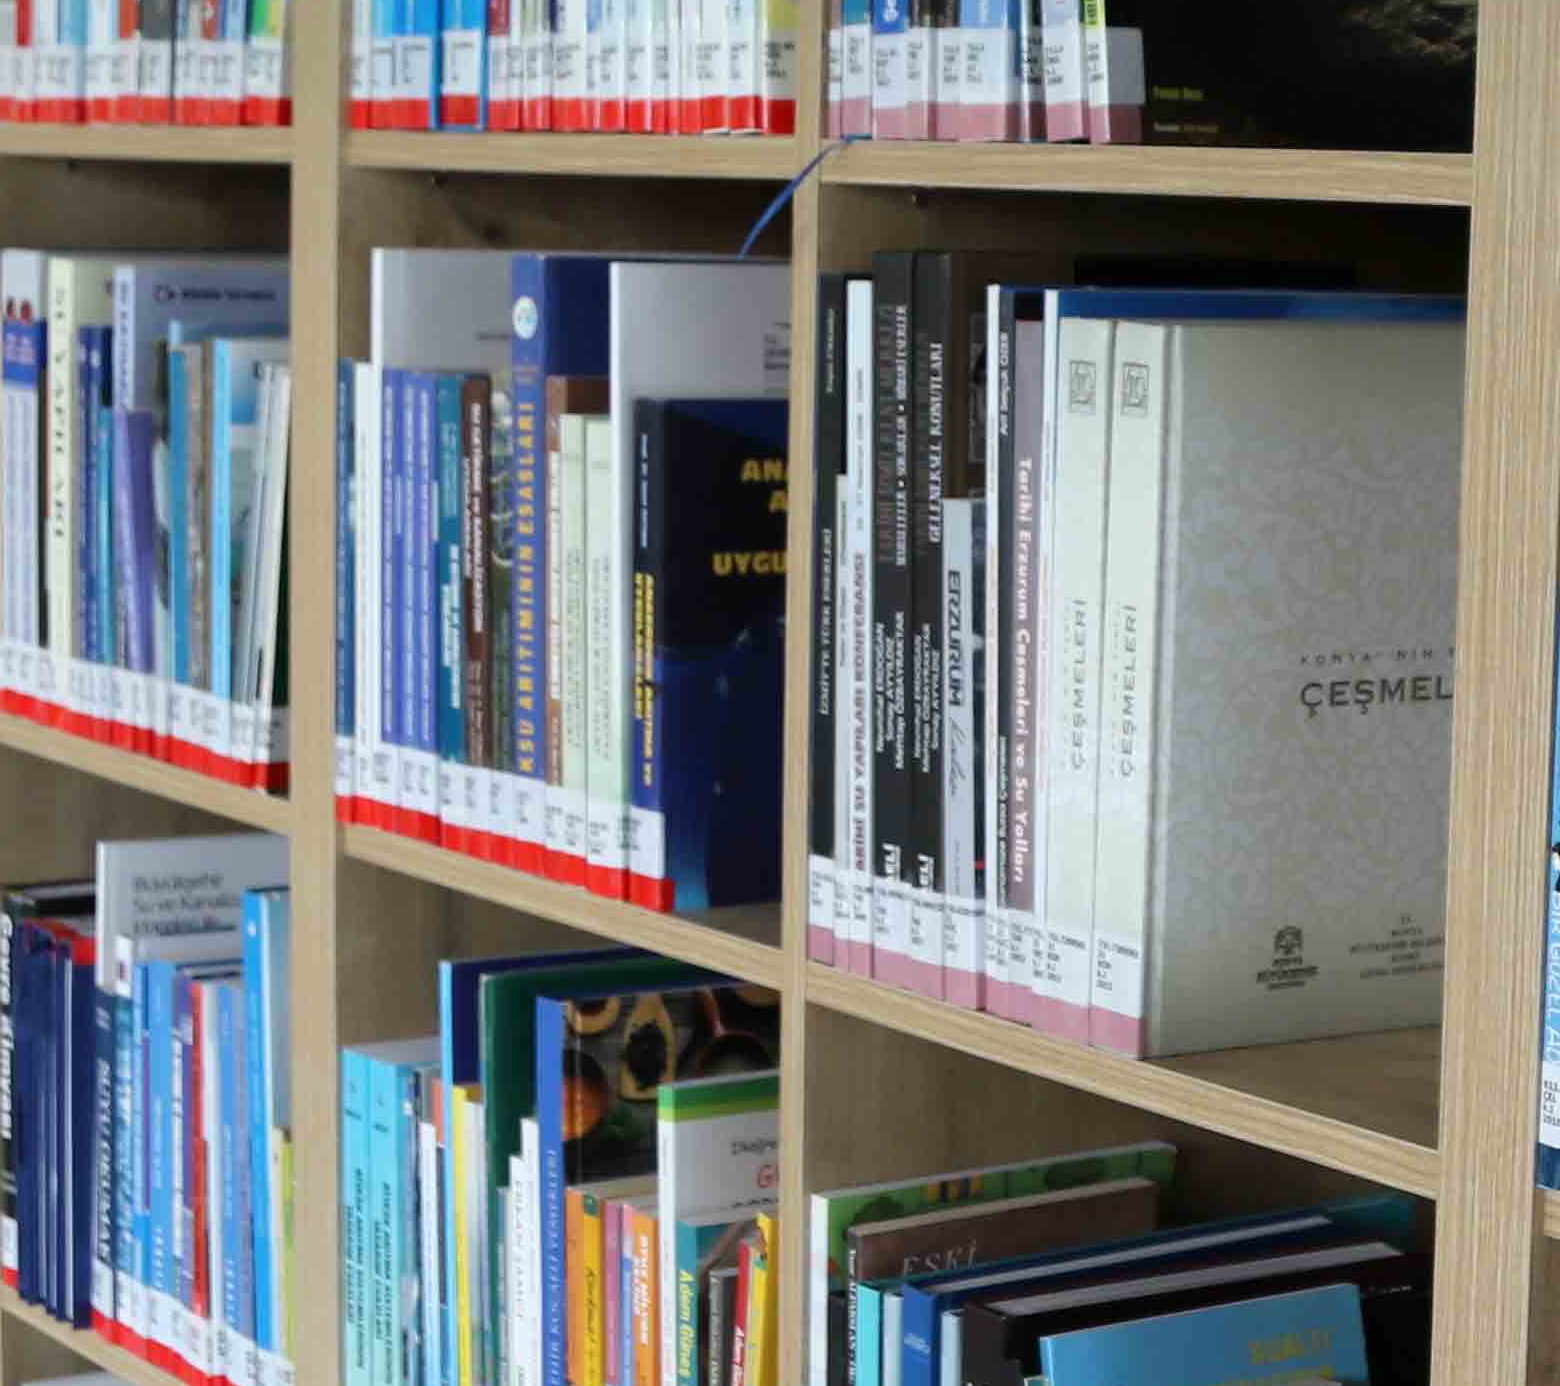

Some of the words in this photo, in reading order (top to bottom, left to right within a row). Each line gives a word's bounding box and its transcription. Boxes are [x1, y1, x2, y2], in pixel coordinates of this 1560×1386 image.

[1016, 529, 1032, 619] Erzurum
[946, 570, 962, 706] ERZURUM
[1300, 676, 1454, 718] ÇEŞMEL
